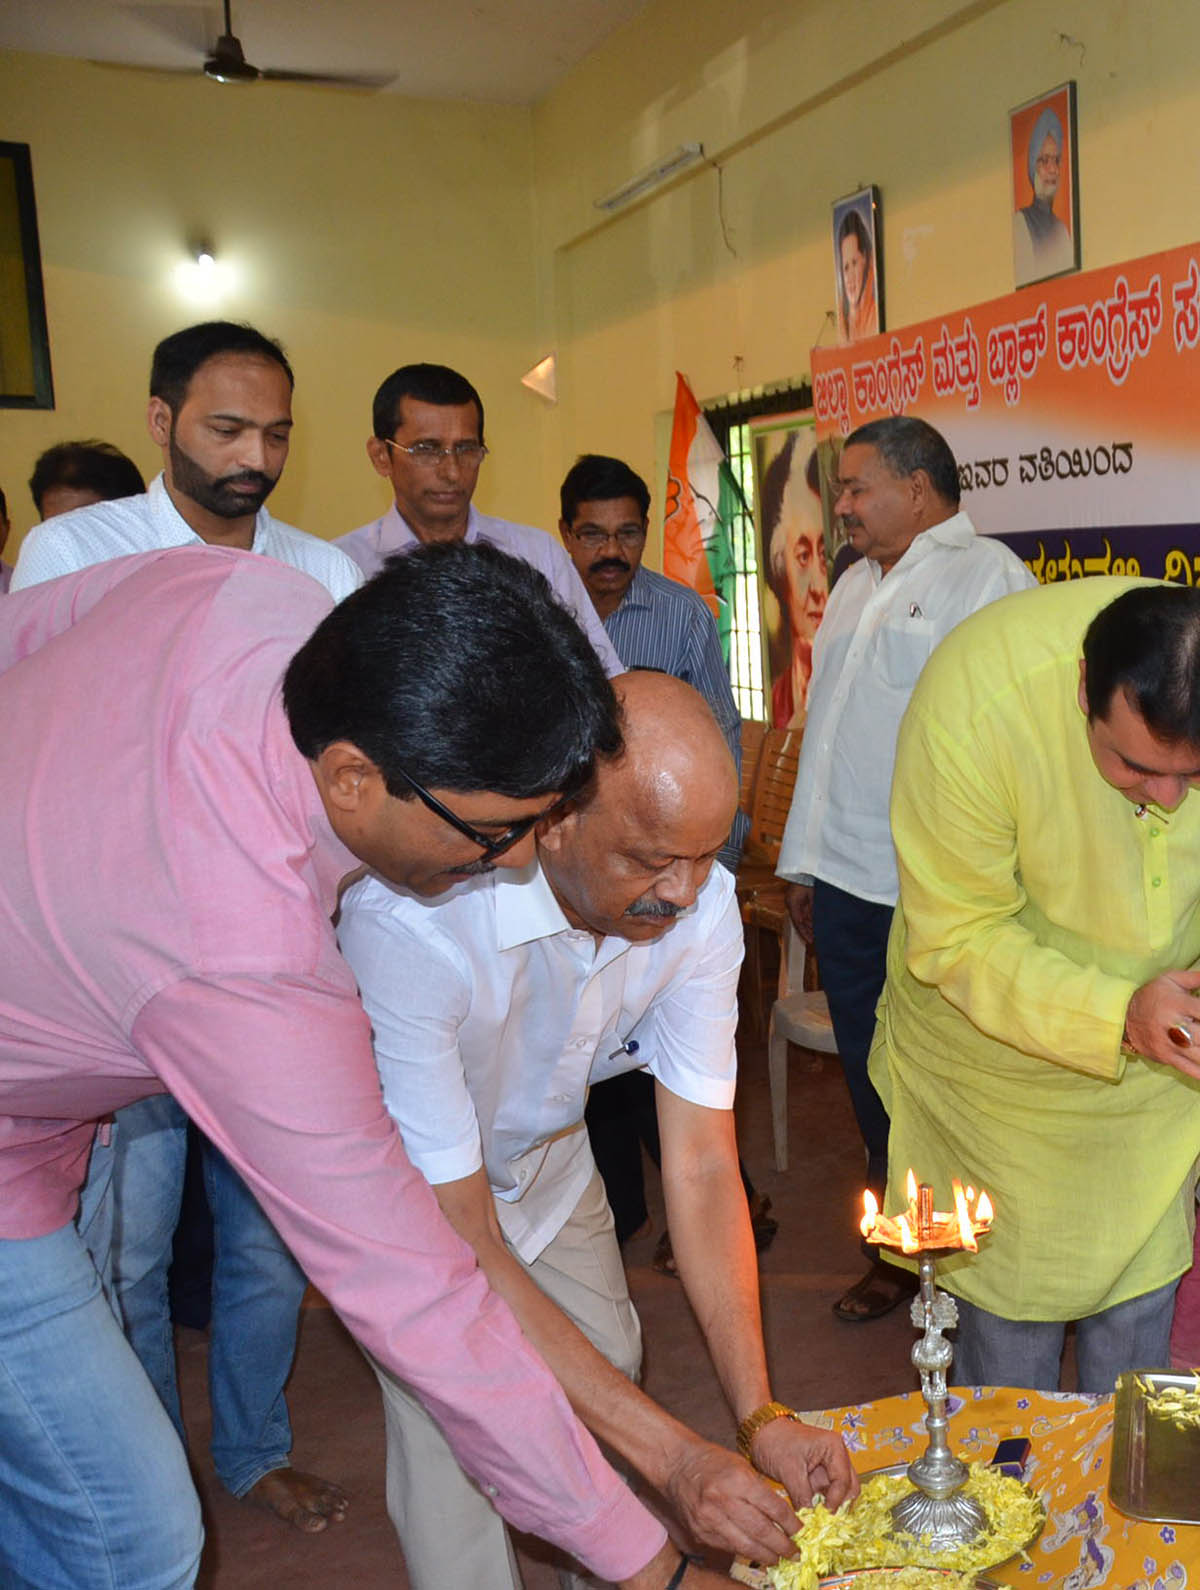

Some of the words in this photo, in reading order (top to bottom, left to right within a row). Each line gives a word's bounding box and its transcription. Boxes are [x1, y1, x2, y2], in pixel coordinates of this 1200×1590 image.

[931, 318, 980, 410] ಮತ್ತು
[987, 303, 1048, 406] ಬ್ಲಾಕ್
[1056, 276, 1161, 385] ಕಾಂಗ್ರೆಸ್
[1018, 441, 1133, 483] ವತಿಯಿಂದ
